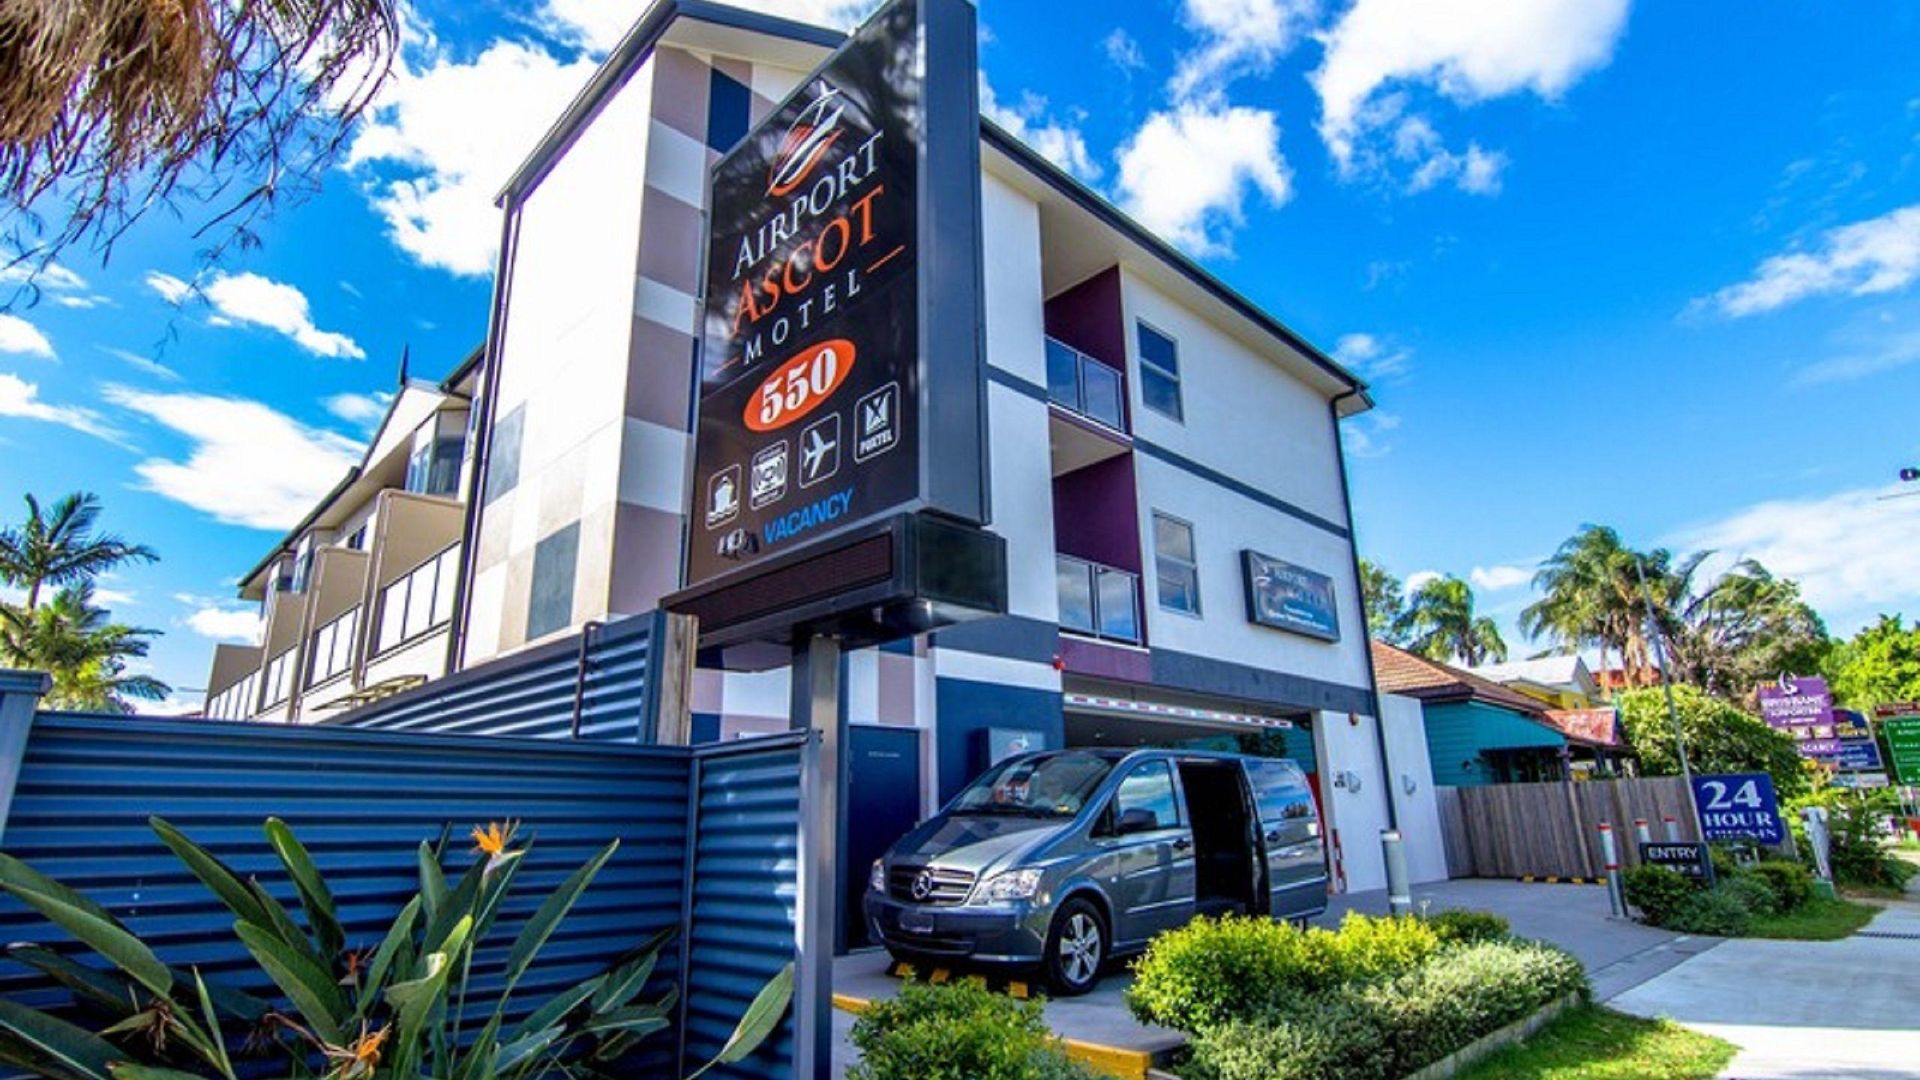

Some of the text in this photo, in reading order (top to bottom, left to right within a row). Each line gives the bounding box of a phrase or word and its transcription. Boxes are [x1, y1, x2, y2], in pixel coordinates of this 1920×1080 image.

[732, 130, 884, 281] AIRPORT
[734, 183, 885, 338] ASCOT
[743, 268, 862, 365] MOTEL
[759, 348, 838, 425] 550
[763, 487, 855, 545] VACANCY
[1701, 780, 1763, 811] 24
[1703, 811, 1774, 828] HOUR
[1647, 846, 1698, 860] ENTRY
